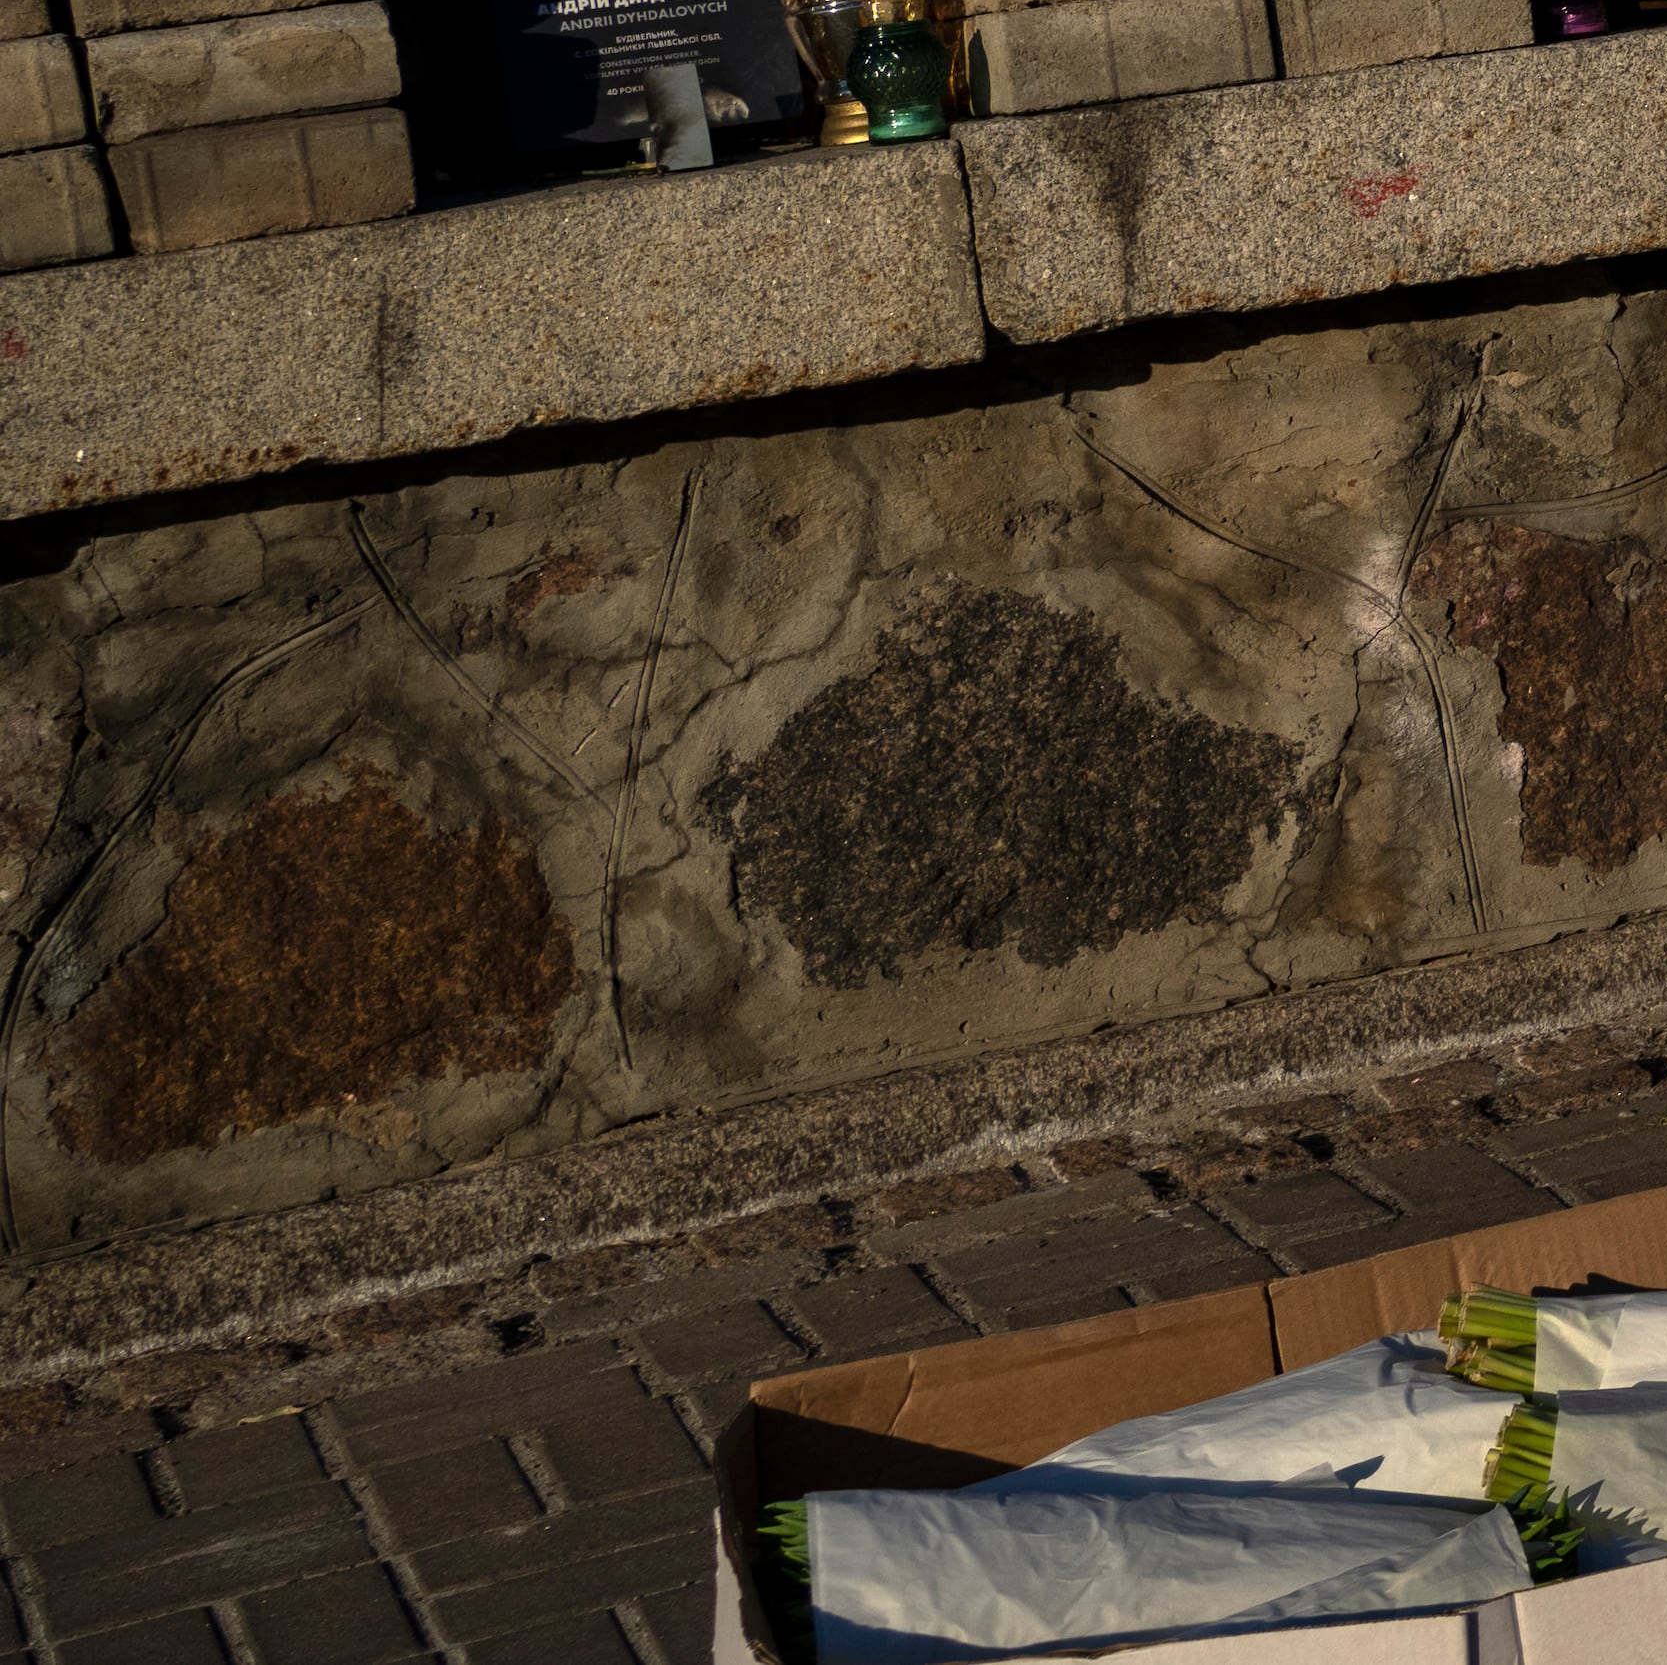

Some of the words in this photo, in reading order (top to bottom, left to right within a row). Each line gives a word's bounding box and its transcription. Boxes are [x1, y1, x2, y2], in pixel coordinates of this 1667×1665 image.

[559, 14, 613, 32] ANDRII
[616, 0, 728, 25] DYHDALOVYCH
[599, 55, 663, 69] CONSTRUCTION
[606, 87, 618, 96] 40
